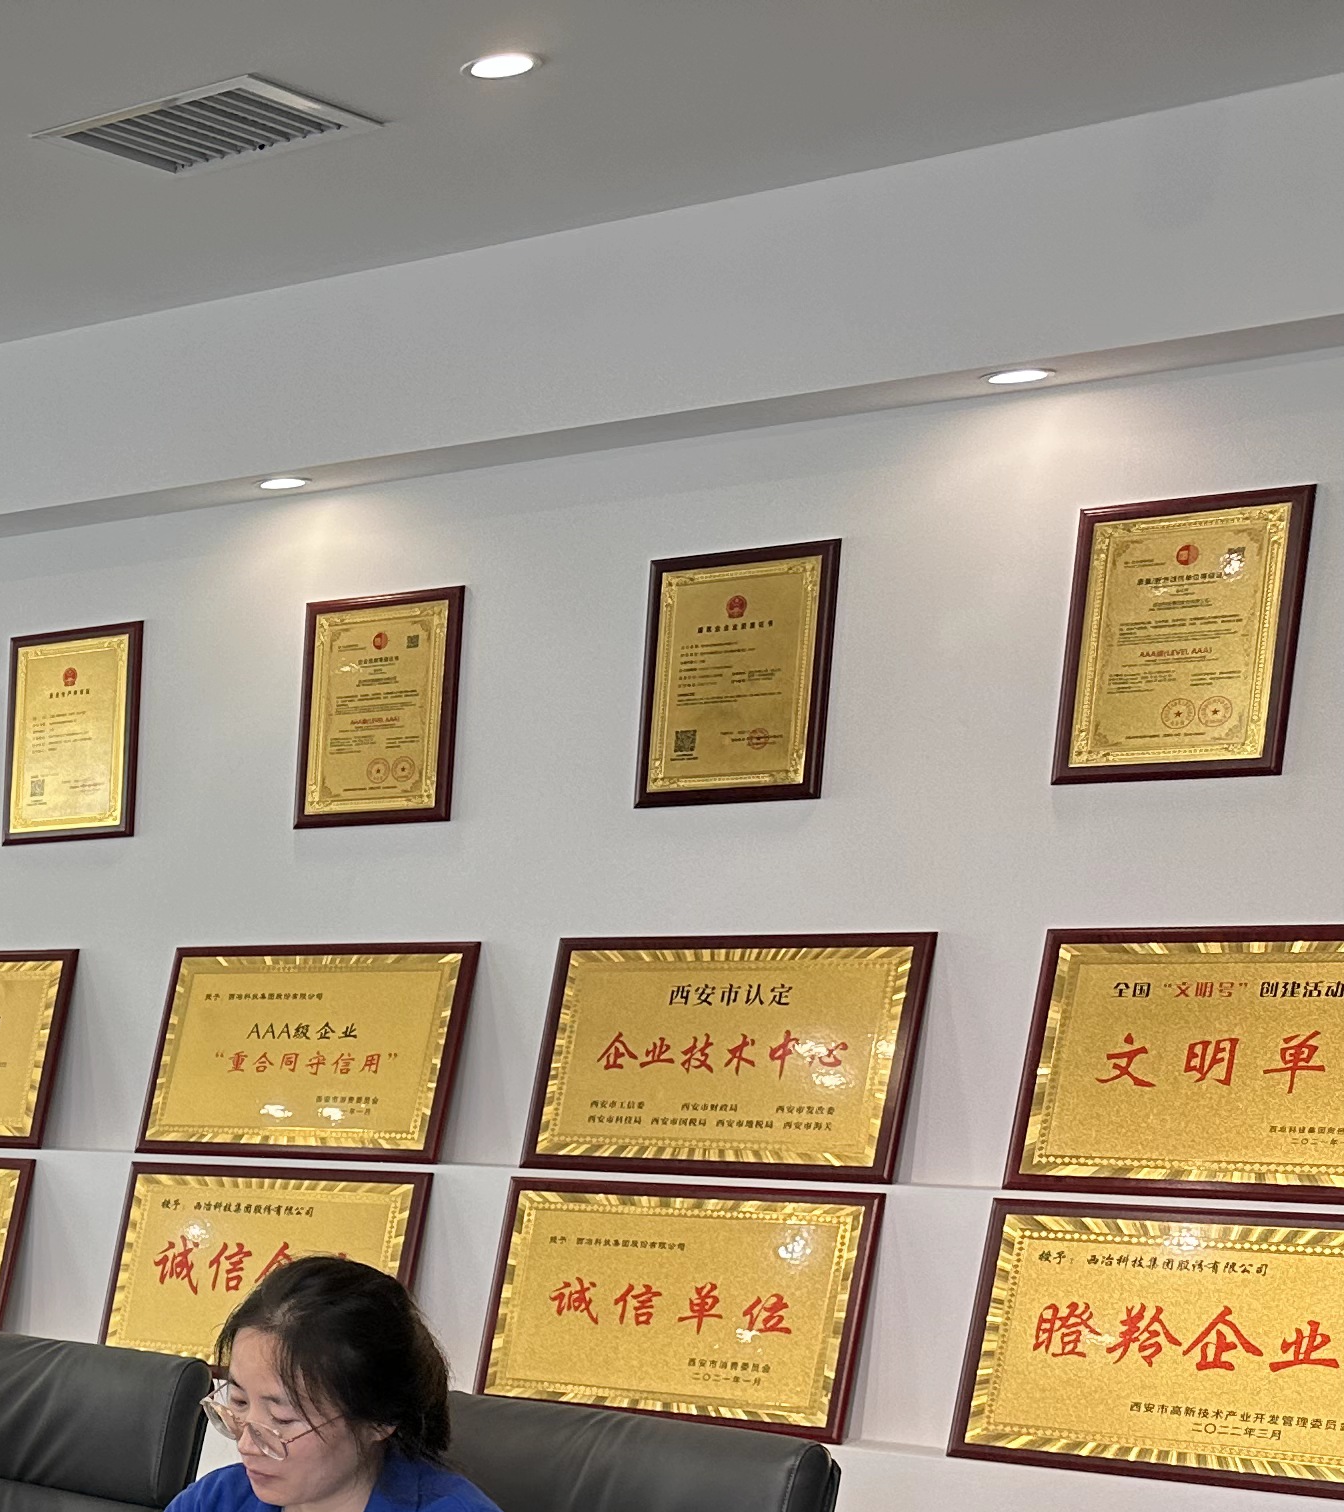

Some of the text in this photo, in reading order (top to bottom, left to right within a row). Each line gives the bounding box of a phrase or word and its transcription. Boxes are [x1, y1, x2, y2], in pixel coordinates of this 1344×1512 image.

[668, 983, 794, 1006] 西安市认定
[1112, 982, 1151, 998] 全国
[1259, 980, 1344, 998] 创建活动
[246, 1022, 358, 1040] AAA级企业
[596, 1029, 849, 1080] 企业技术中心
[1094, 1030, 1326, 1094] 文明单
[154, 1235, 347, 1296] 诚信
[549, 1276, 792, 1335] 诚信单位
[1032, 1300, 1340, 1373] 瞪羚企业
